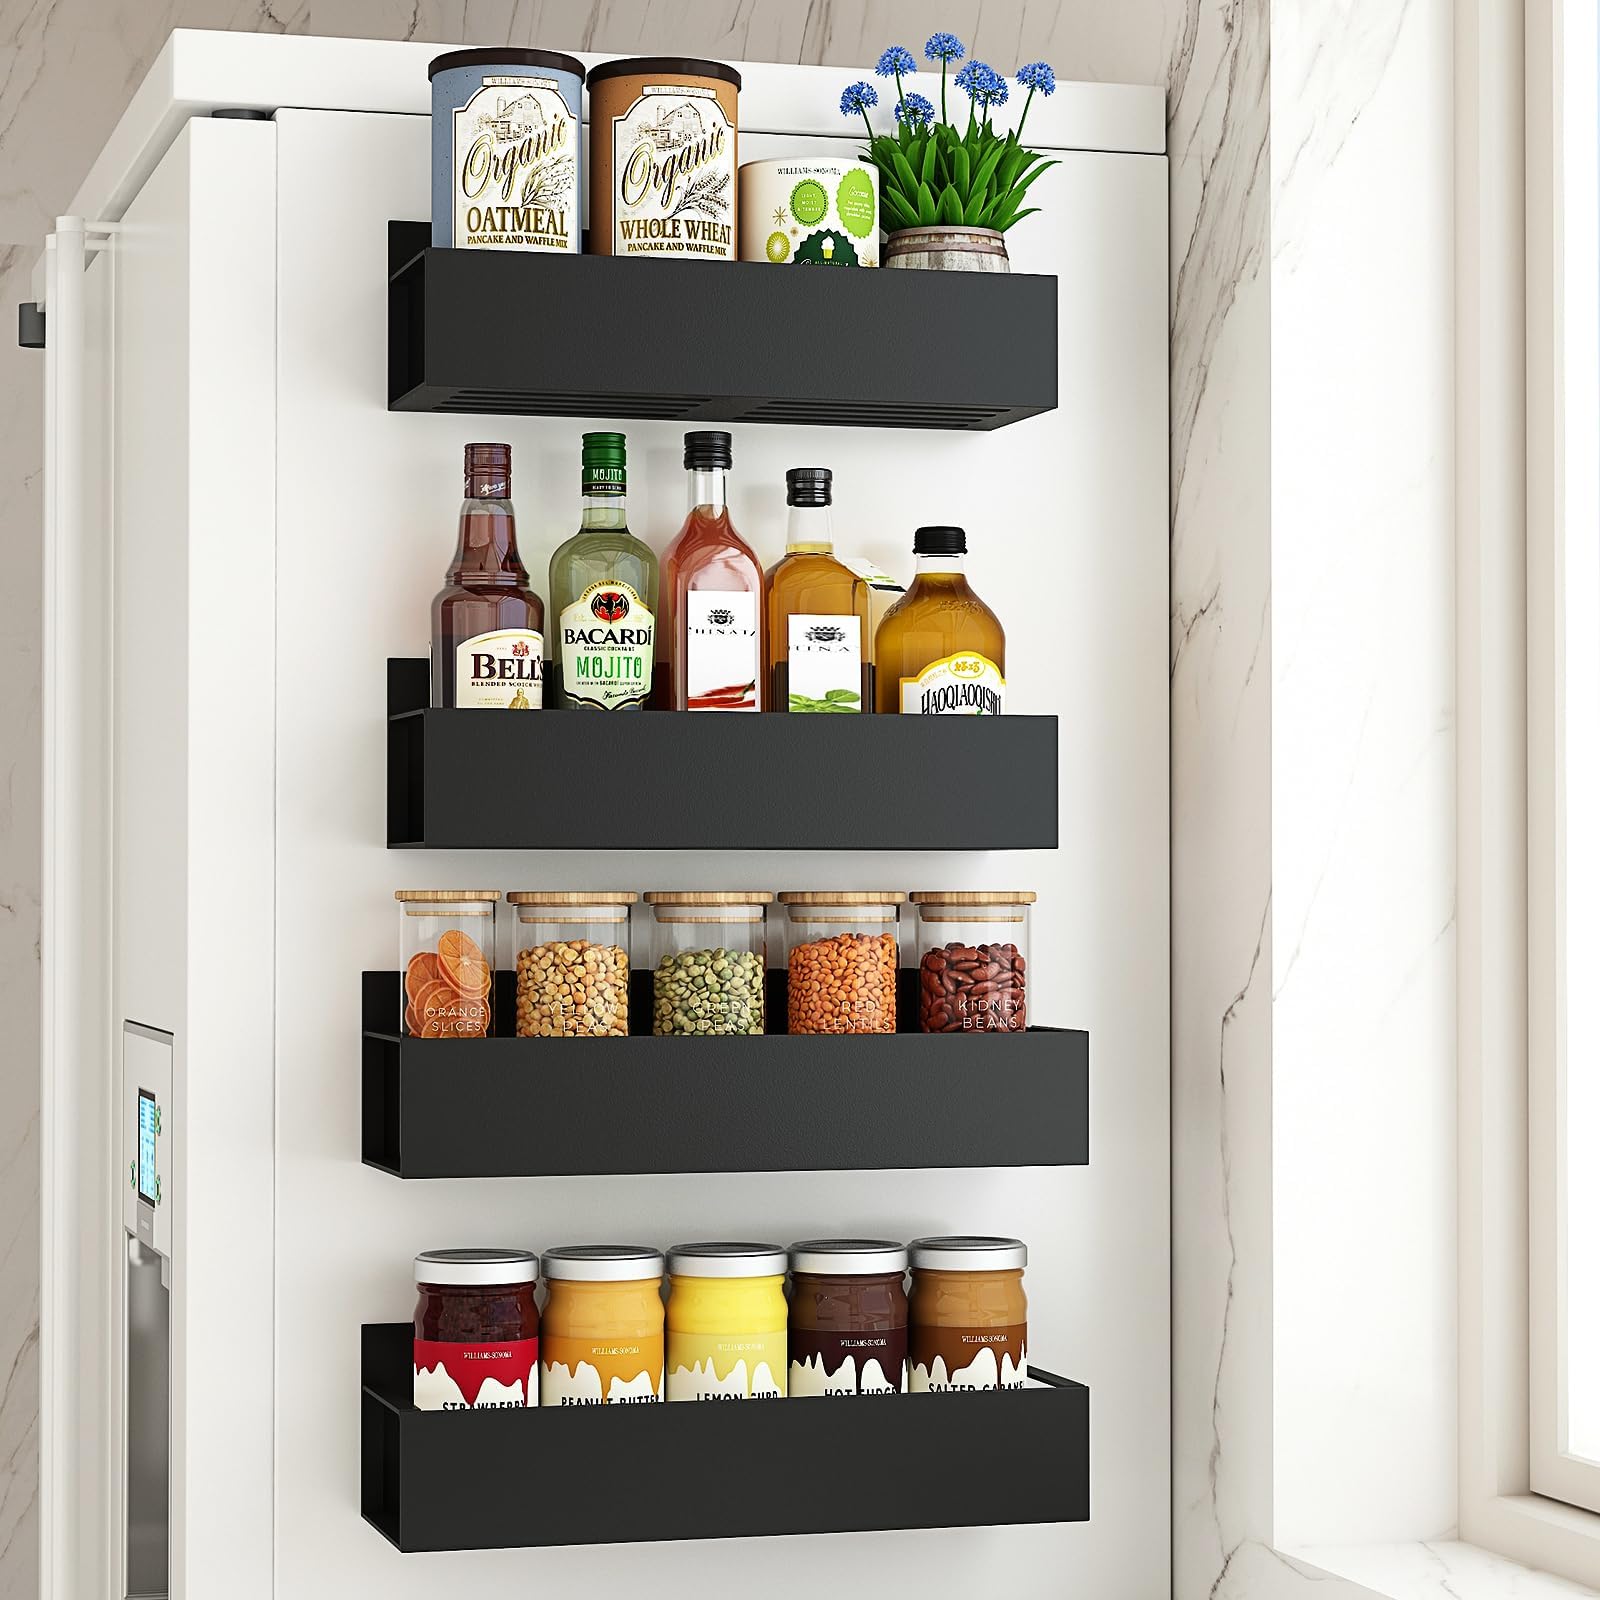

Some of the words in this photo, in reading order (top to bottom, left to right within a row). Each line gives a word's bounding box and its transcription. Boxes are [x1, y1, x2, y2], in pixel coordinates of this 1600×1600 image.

[462, 113, 567, 202] Organic
[622, 121, 725, 210] Organic
[467, 206, 568, 237] OATMEAL
[620, 218, 682, 240] WHOLE
[684, 219, 732, 246] WHEAT
[467, 234, 504, 244] PANCAKE
[505, 235, 524, 244] AND
[525, 235, 555, 246] WAFFLE
[556, 238, 568, 249] MIX
[627, 242, 664, 252] PANCAKE
[665, 242, 684, 252] AND
[686, 243, 714, 254] WAFFLE
[715, 246, 726, 256] MIX
[592, 468, 622, 481] MOJITO
[564, 625, 652, 646] BACARDÍ
[576, 656, 642, 679] MOJITO
[426, 1007, 486, 1017] ORANGE
[548, 1003, 618, 1015] YELLOW
[692, 1001, 751, 1014] GREEN
[841, 1000, 876, 1013] RED
[958, 999, 1020, 1012] KIDNEY
[431, 1021, 482, 1032] SLICES
[563, 1020, 610, 1033] PEAS
[701, 1019, 746, 1031] PEAS
[822, 1018, 890, 1031] LENTILS
[963, 1016, 1018, 1029] BEANS
